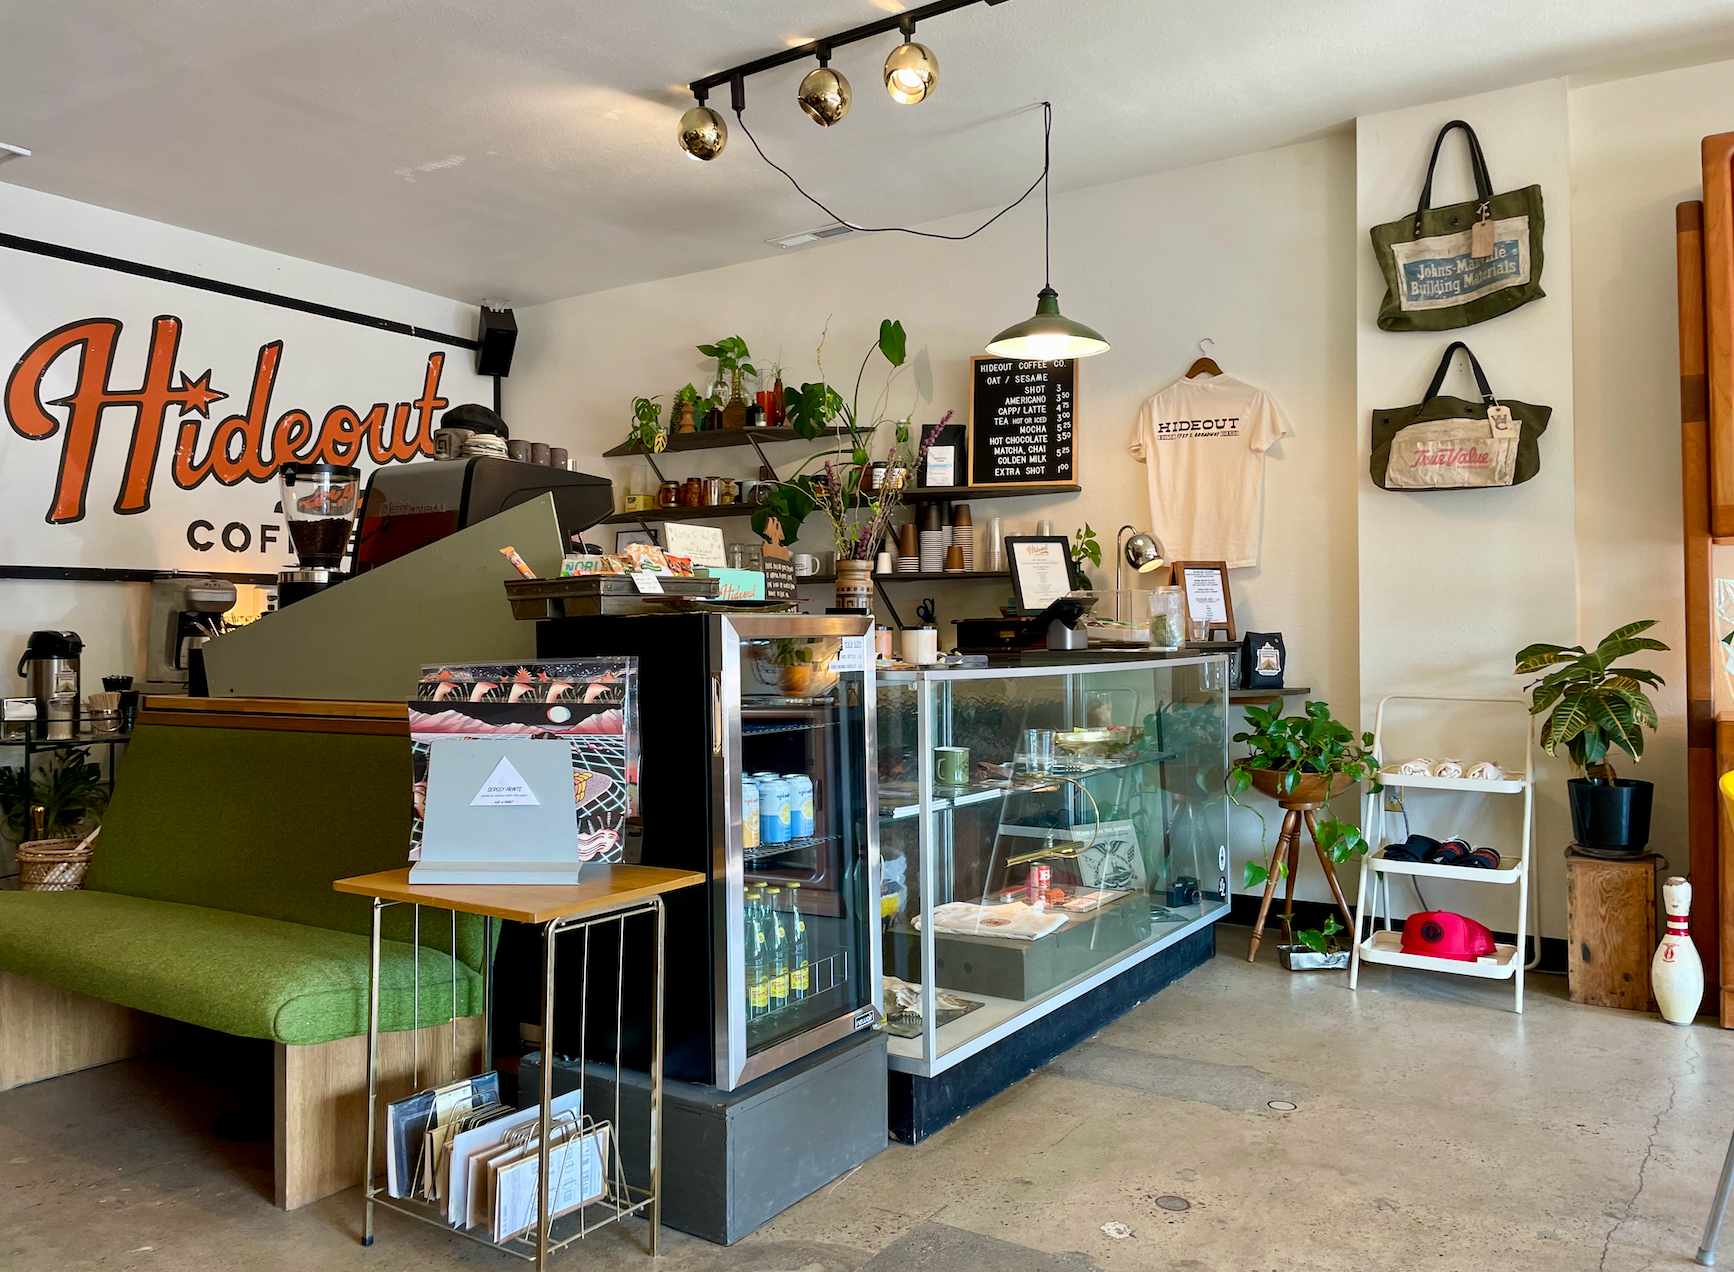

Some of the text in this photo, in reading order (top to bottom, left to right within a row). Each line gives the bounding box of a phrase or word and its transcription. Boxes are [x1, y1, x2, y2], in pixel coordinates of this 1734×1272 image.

[1410, 259, 1517, 296] Building Materials
[980, 359, 1067, 373] HIDEOUT COFFEE CO.
[986, 376, 1001, 385] OAT
[1014, 373, 1049, 384] SESAME
[1024, 384, 1062, 395] SHOT 3
[1004, 395, 1047, 405] AMERICANO
[1022, 404, 1047, 415] LATTE
[4, 314, 450, 525] Hideout
[993, 417, 1009, 426] TEA
[1012, 417, 1024, 425] HOT
[1024, 417, 1033, 425] OR
[1033, 416, 1048, 424] ICED
[1158, 417, 1240, 433] HIDEOUT
[1019, 425, 1047, 434] MOCHA
[989, 436, 1004, 446] HOT
[1005, 434, 1049, 445] CHOCOLATE
[1028, 444, 1047, 454] CHAI
[997, 454, 1048, 465] GOLDEN MILK
[1409, 446, 1490, 469] True Value
[994, 467, 1021, 477] EXTRA
[1025, 465, 1046, 475] SHOT
[565, 560, 599, 571] NORI
[719, 583, 757, 600] Hideout
